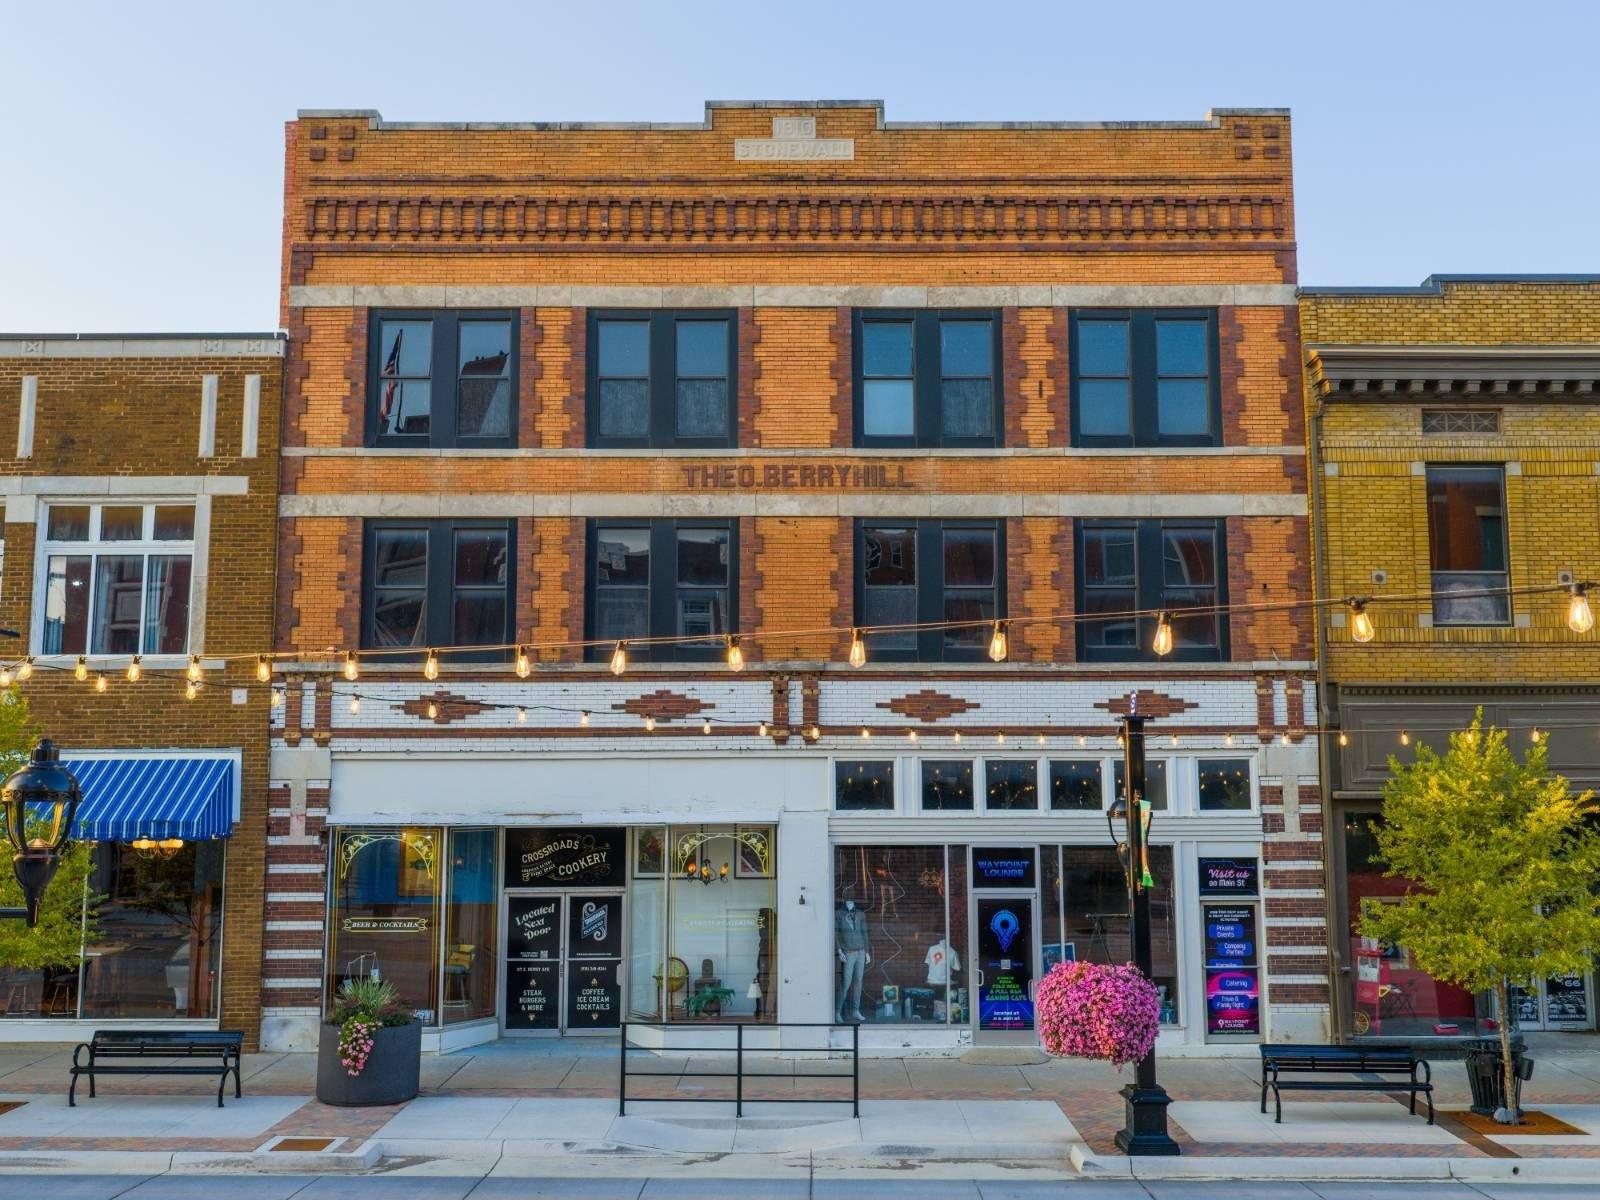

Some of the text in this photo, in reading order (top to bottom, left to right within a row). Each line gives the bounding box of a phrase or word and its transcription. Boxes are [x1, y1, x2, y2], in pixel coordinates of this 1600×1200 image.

[738, 142, 851, 158] STONEWALL
[521, 839, 581, 864] CROSSROADS
[558, 851, 607, 876] COOKERY
[977, 860, 1030, 869] WAYPOINT
[984, 869, 1024, 877] LOUNGE
[1208, 868, 1250, 879] Visit us
[1218, 879, 1236, 887] Main
[1236, 879, 1246, 887] St
[515, 903, 555, 926] Located
[524, 917, 545, 931] Next
[523, 927, 552, 940] Door
[1224, 942, 1246, 950] Company
[1225, 979, 1248, 988] Catering
[523, 989, 543, 997] STEAK
[581, 988, 605, 996] COFFEE
